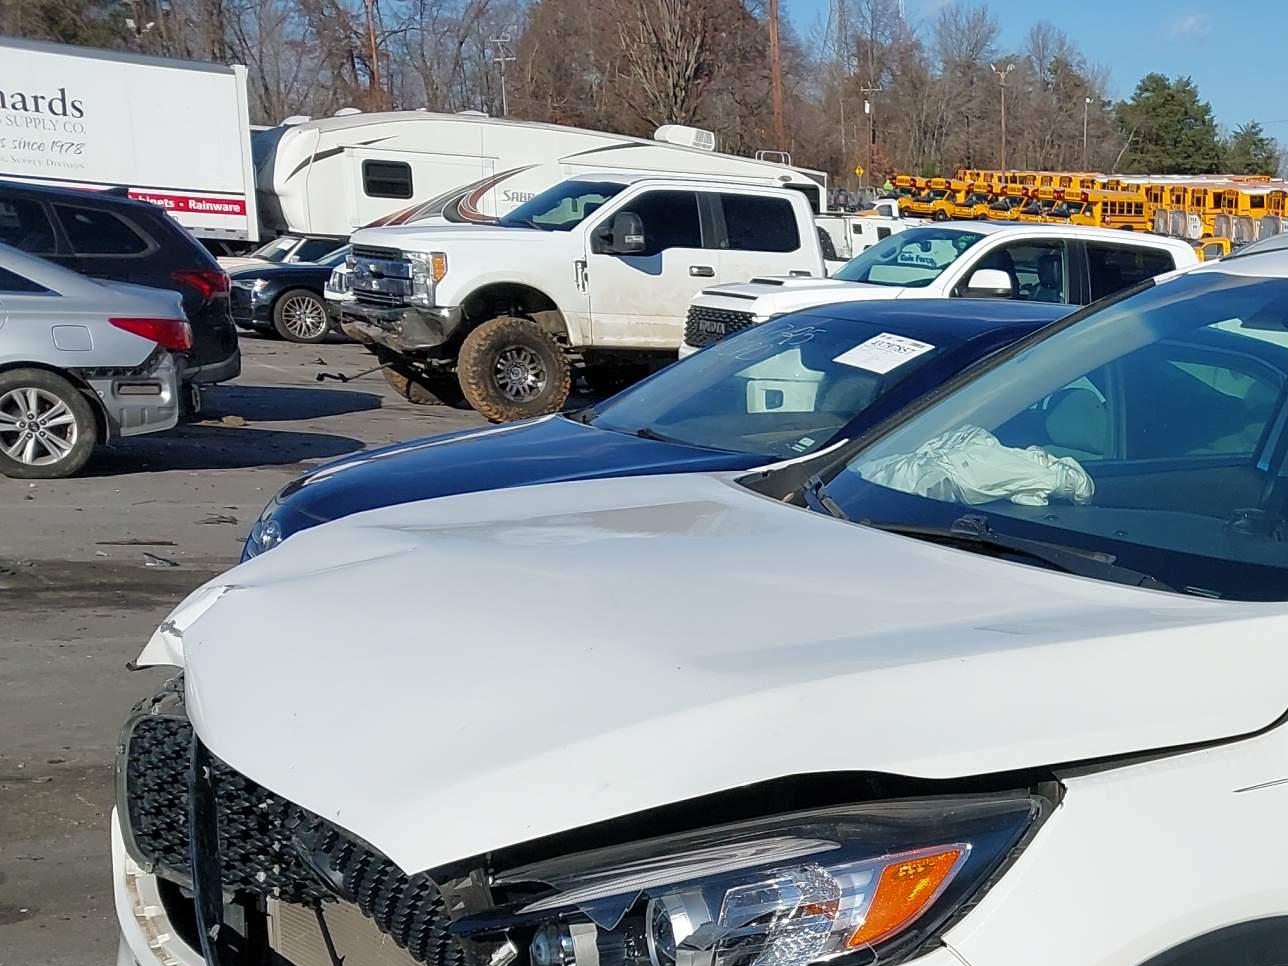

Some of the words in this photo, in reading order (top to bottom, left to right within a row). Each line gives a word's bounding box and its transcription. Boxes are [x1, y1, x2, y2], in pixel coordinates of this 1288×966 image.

[6, 115, 58, 131] SUPPLY
[12, 138, 46, 151] since
[51, 140, 86, 154] 1978
[188, 199, 241, 212] Rainware
